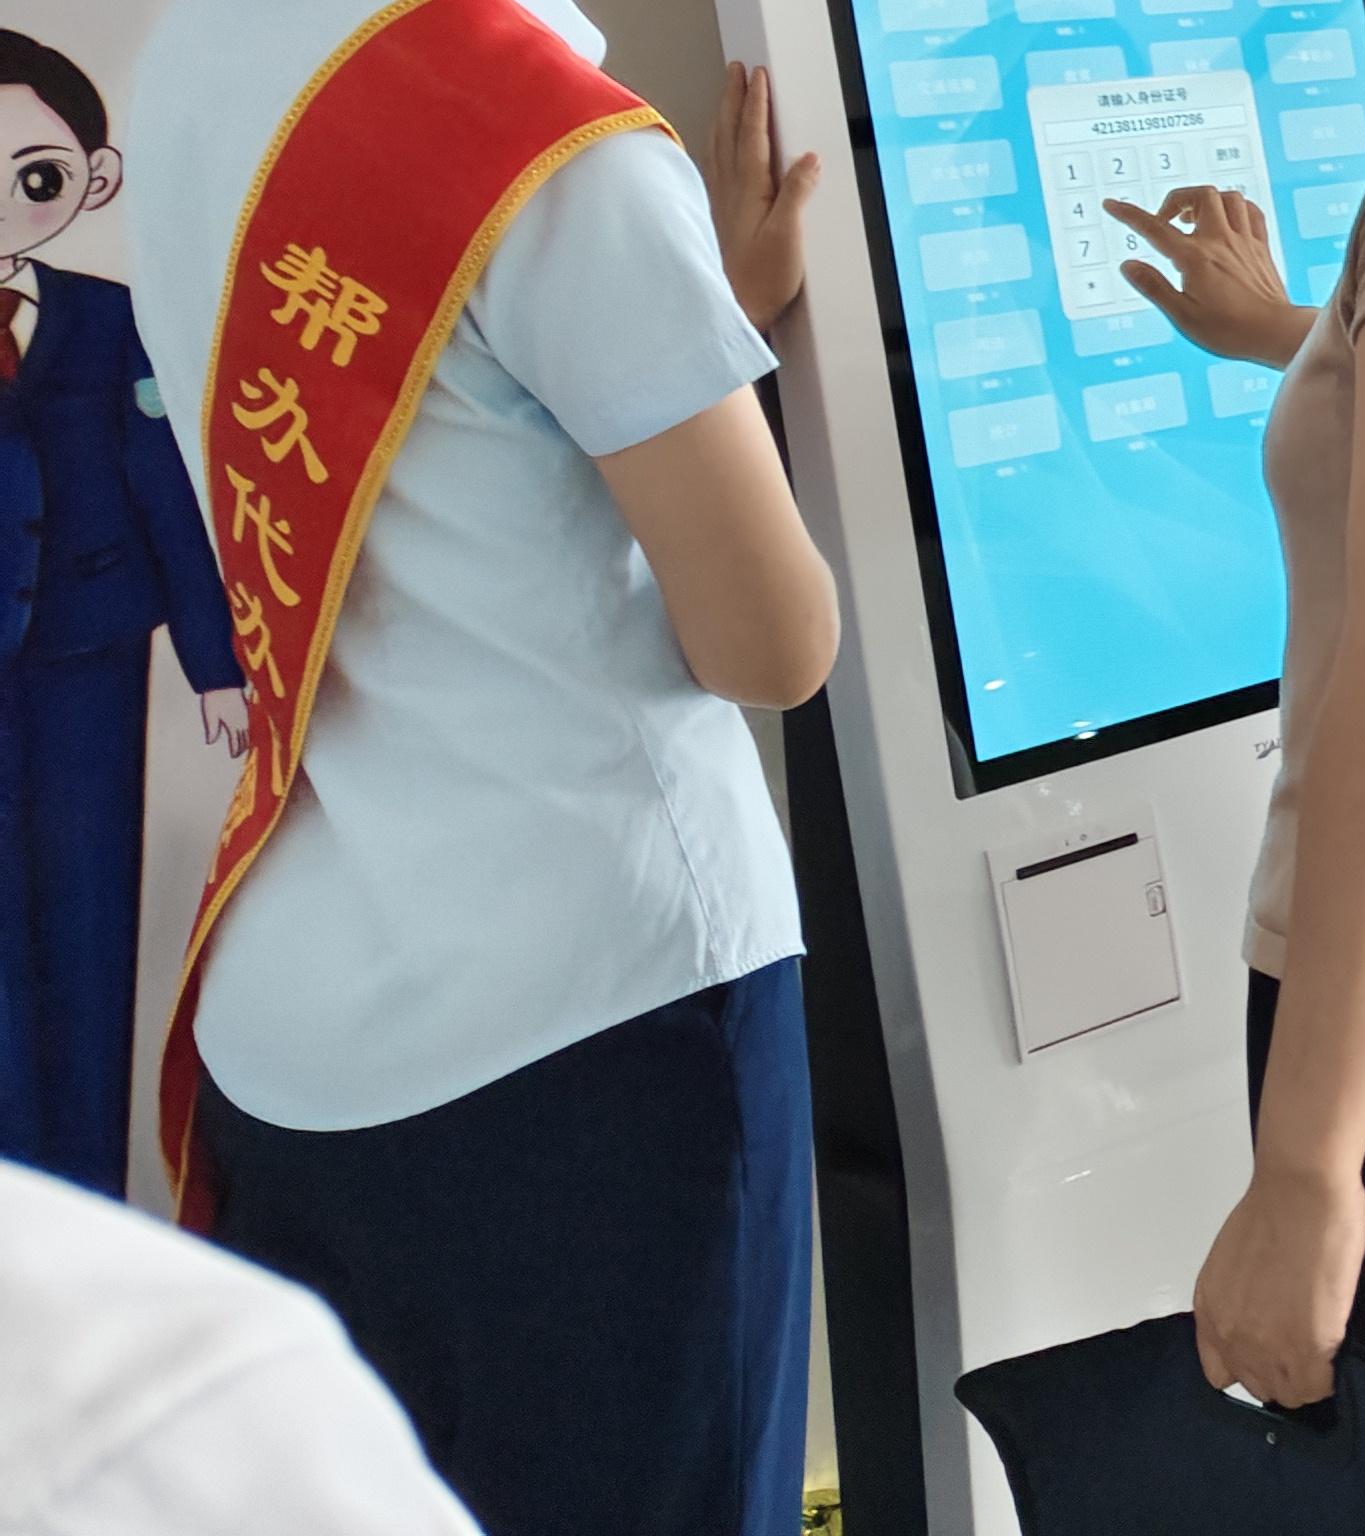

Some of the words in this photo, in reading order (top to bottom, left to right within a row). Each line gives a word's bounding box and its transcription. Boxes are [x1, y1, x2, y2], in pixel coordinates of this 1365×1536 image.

[1098, 87, 1188, 107] 请输入身份证号
[1067, 164, 1078, 181] 1
[1112, 157, 1125, 175] 2
[1159, 153, 1172, 170] 3
[1073, 202, 1085, 218] 4
[1077, 240, 1090, 257] 7
[1126, 233, 1138, 251] 8
